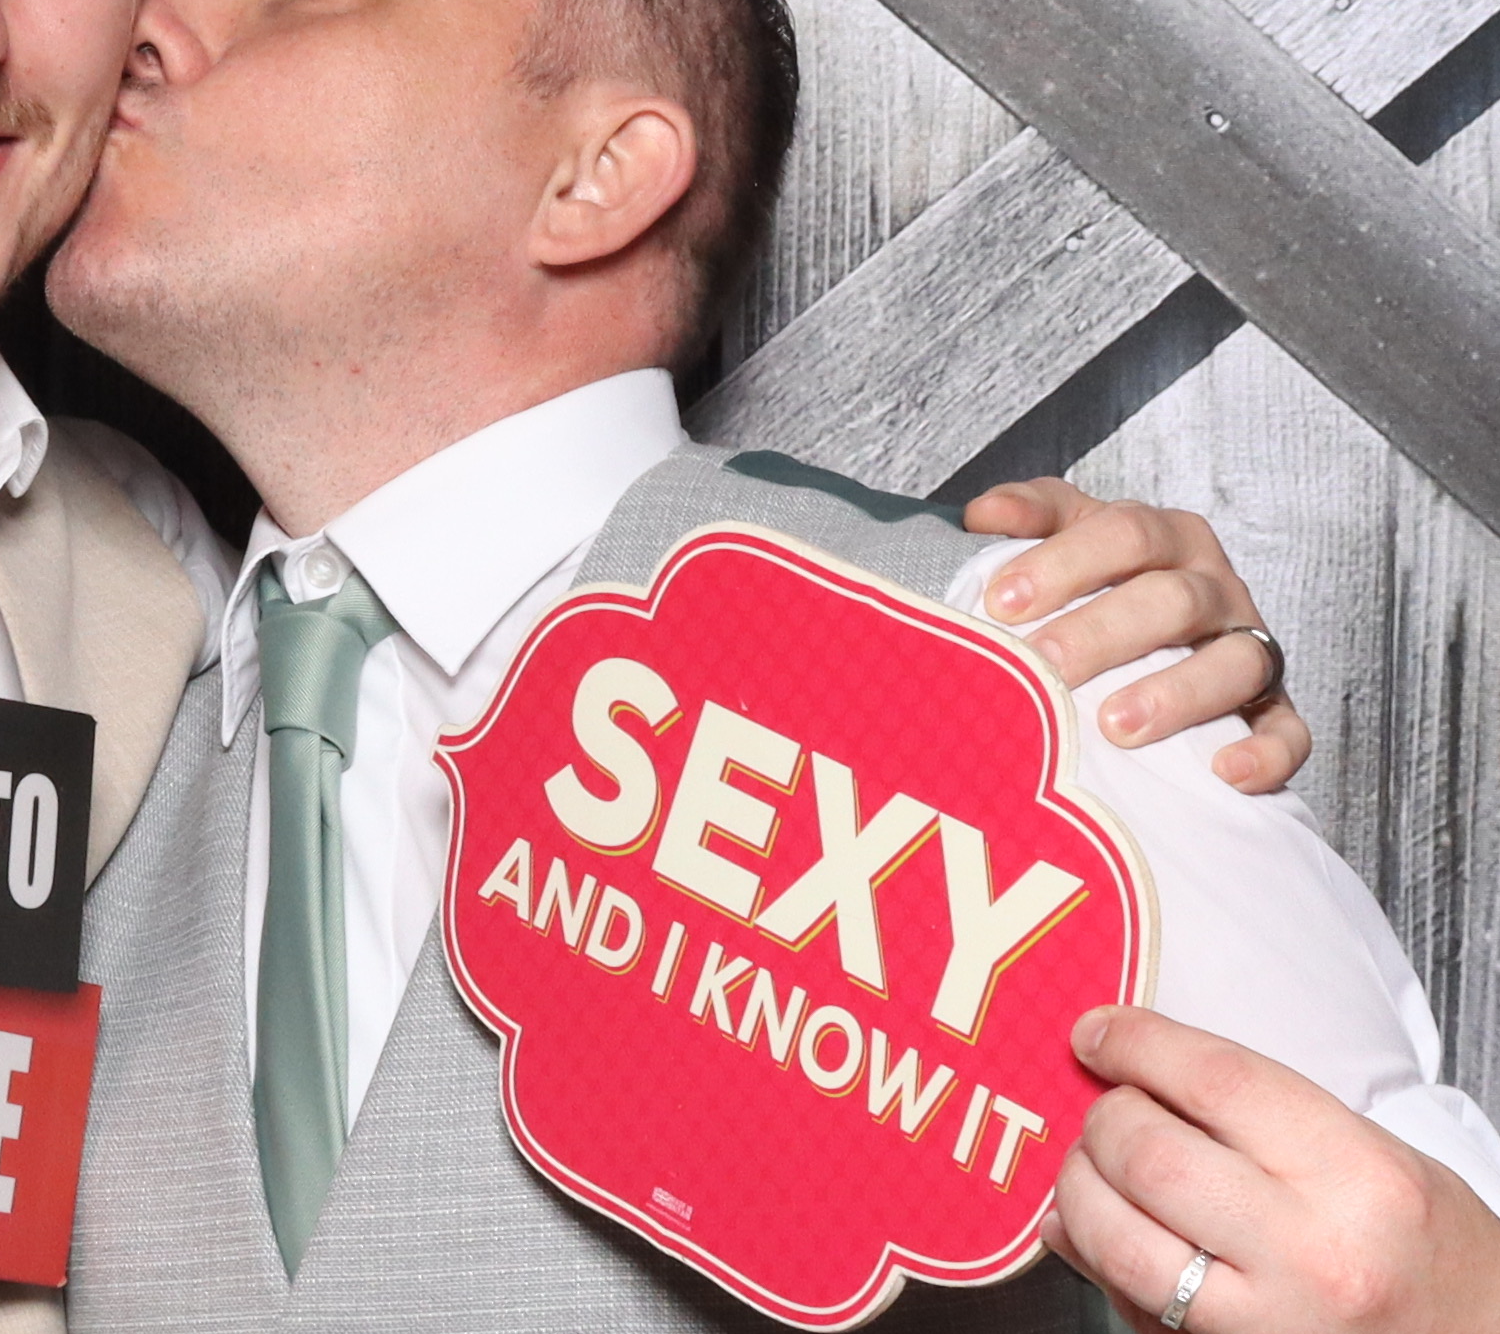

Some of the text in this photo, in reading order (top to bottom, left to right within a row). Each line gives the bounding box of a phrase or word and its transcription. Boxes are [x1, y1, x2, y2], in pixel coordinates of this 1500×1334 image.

[479, 838, 1046, 1187] AND I KNOW IT
[544, 658, 1086, 1040] SEXY
